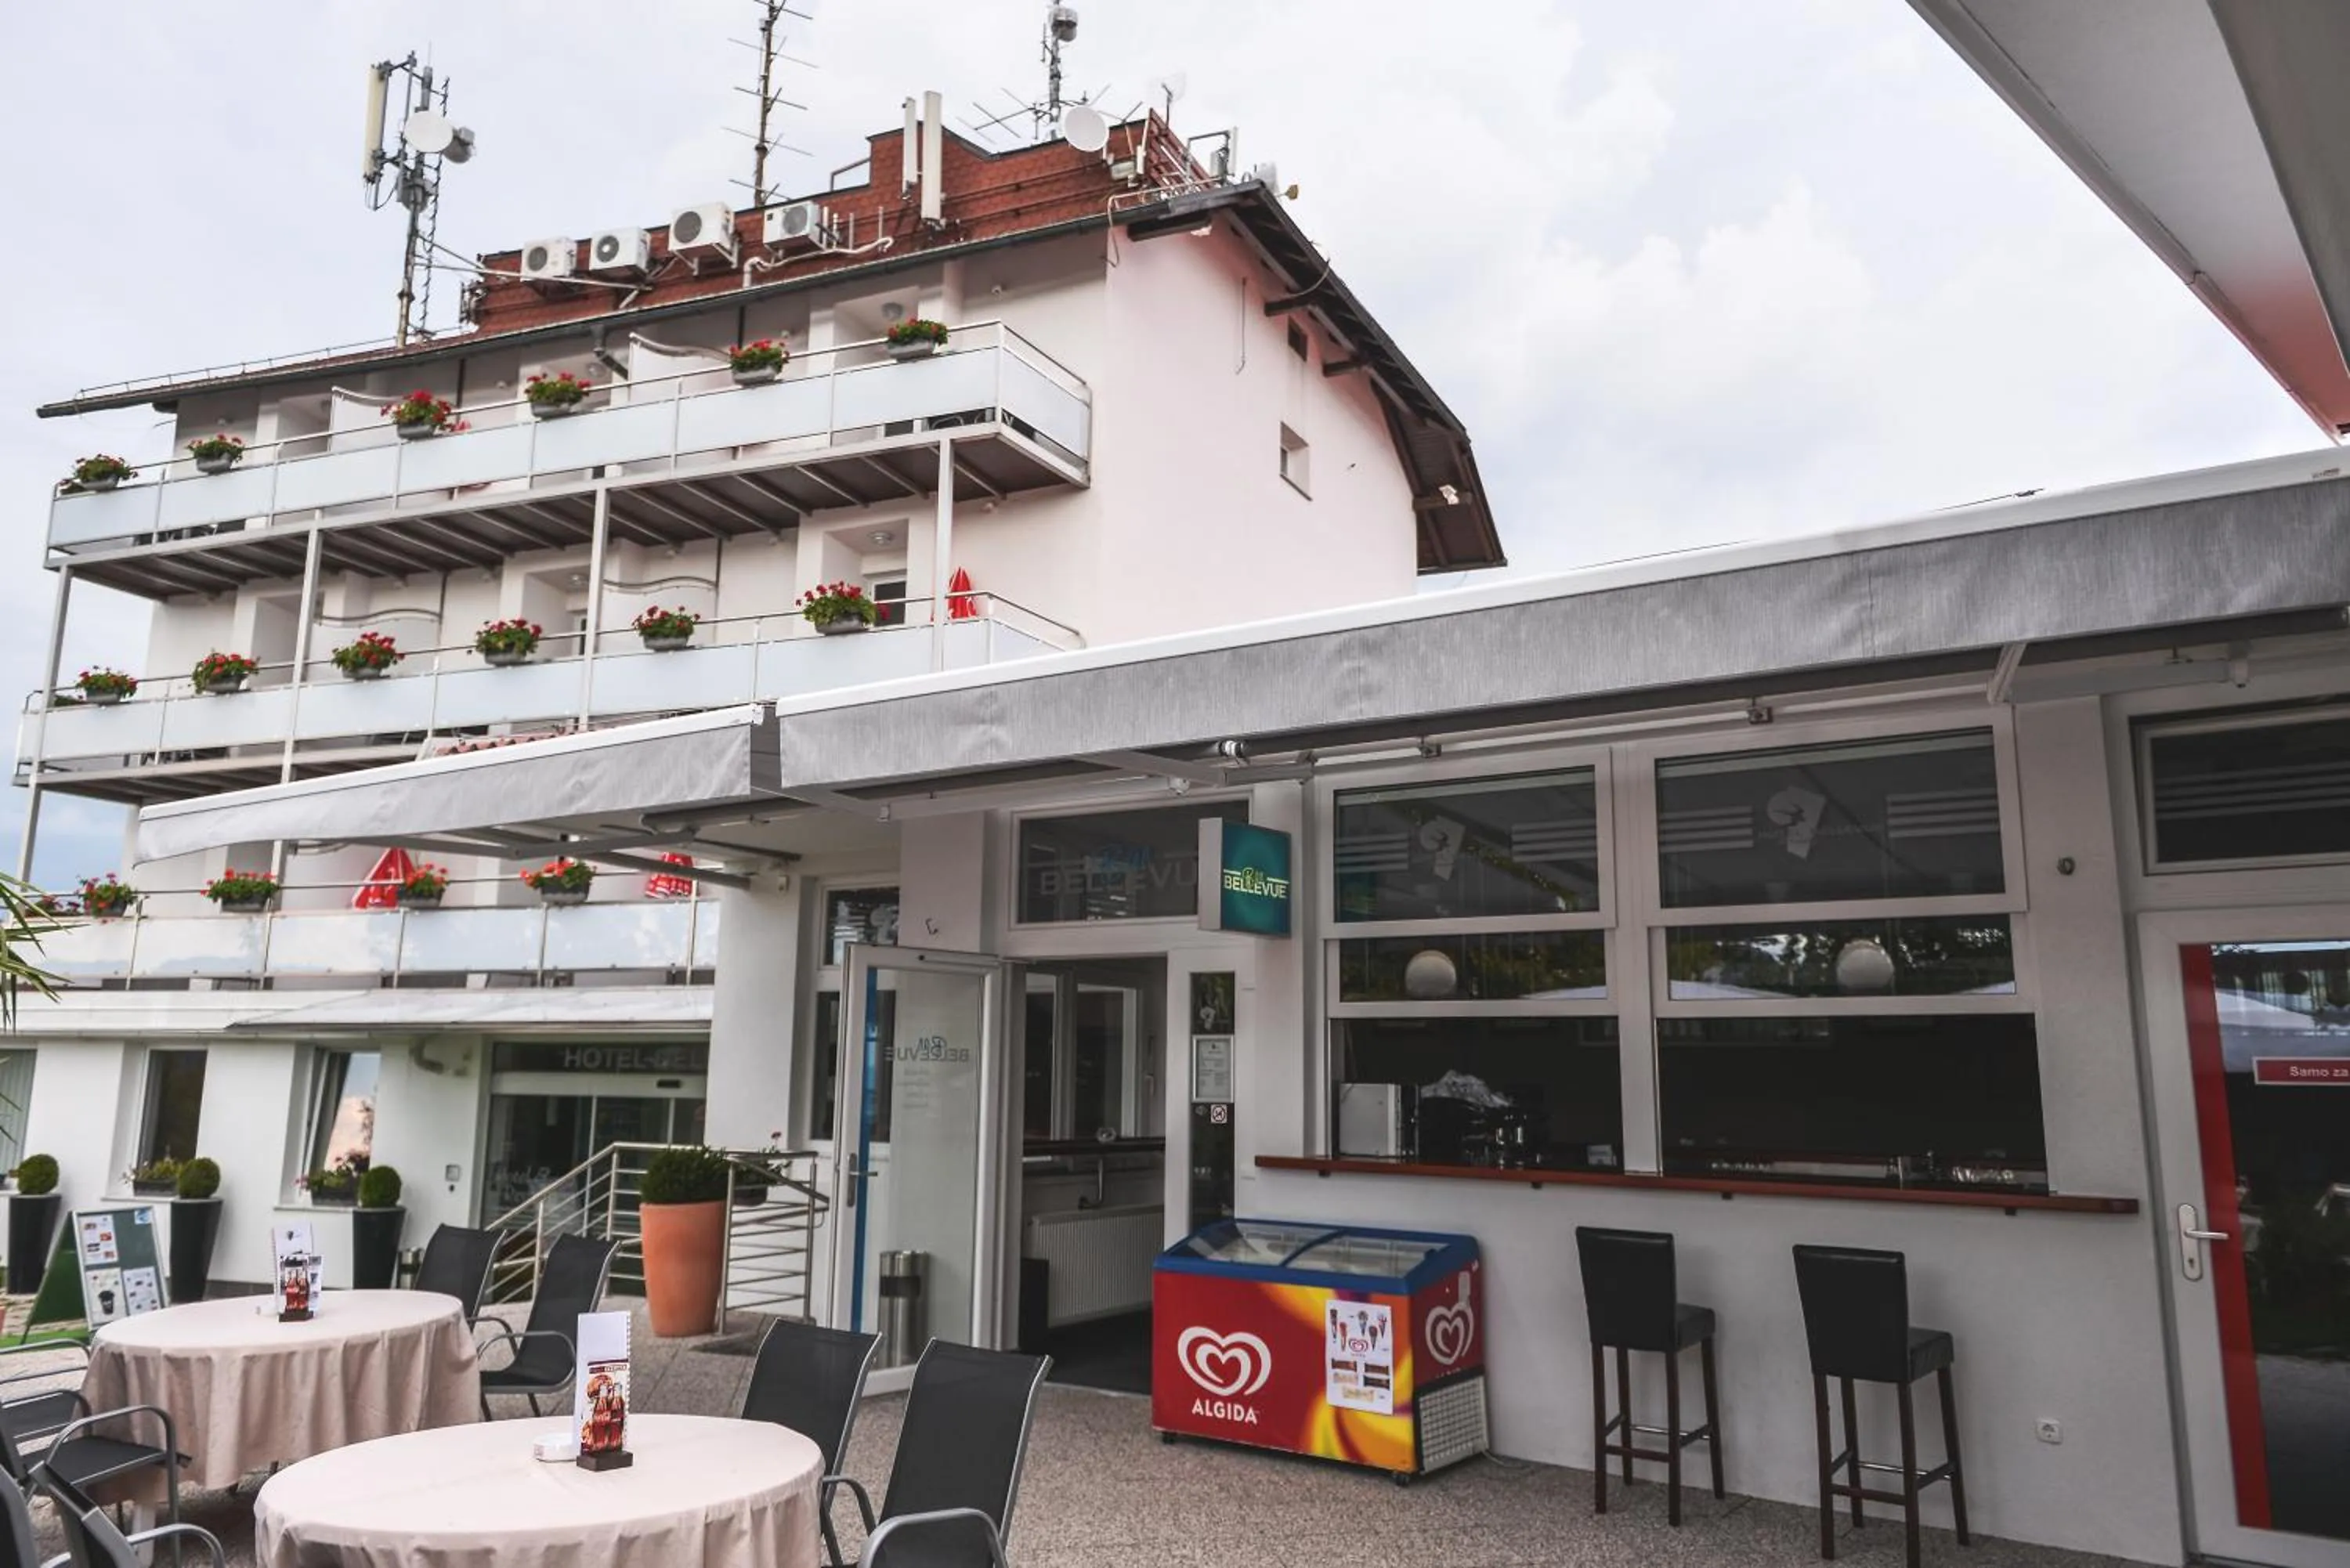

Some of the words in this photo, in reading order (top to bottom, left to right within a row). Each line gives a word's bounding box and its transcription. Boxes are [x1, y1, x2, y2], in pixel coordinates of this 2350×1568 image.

[1039, 860, 1198, 895] BELLEVU
[1224, 875, 1287, 898] BELLEVUE
[563, 1046, 645, 1068] HOTEL
[2290, 1066, 2330, 1077] Samo
[1191, 1398, 1258, 1425] ALGIDA
